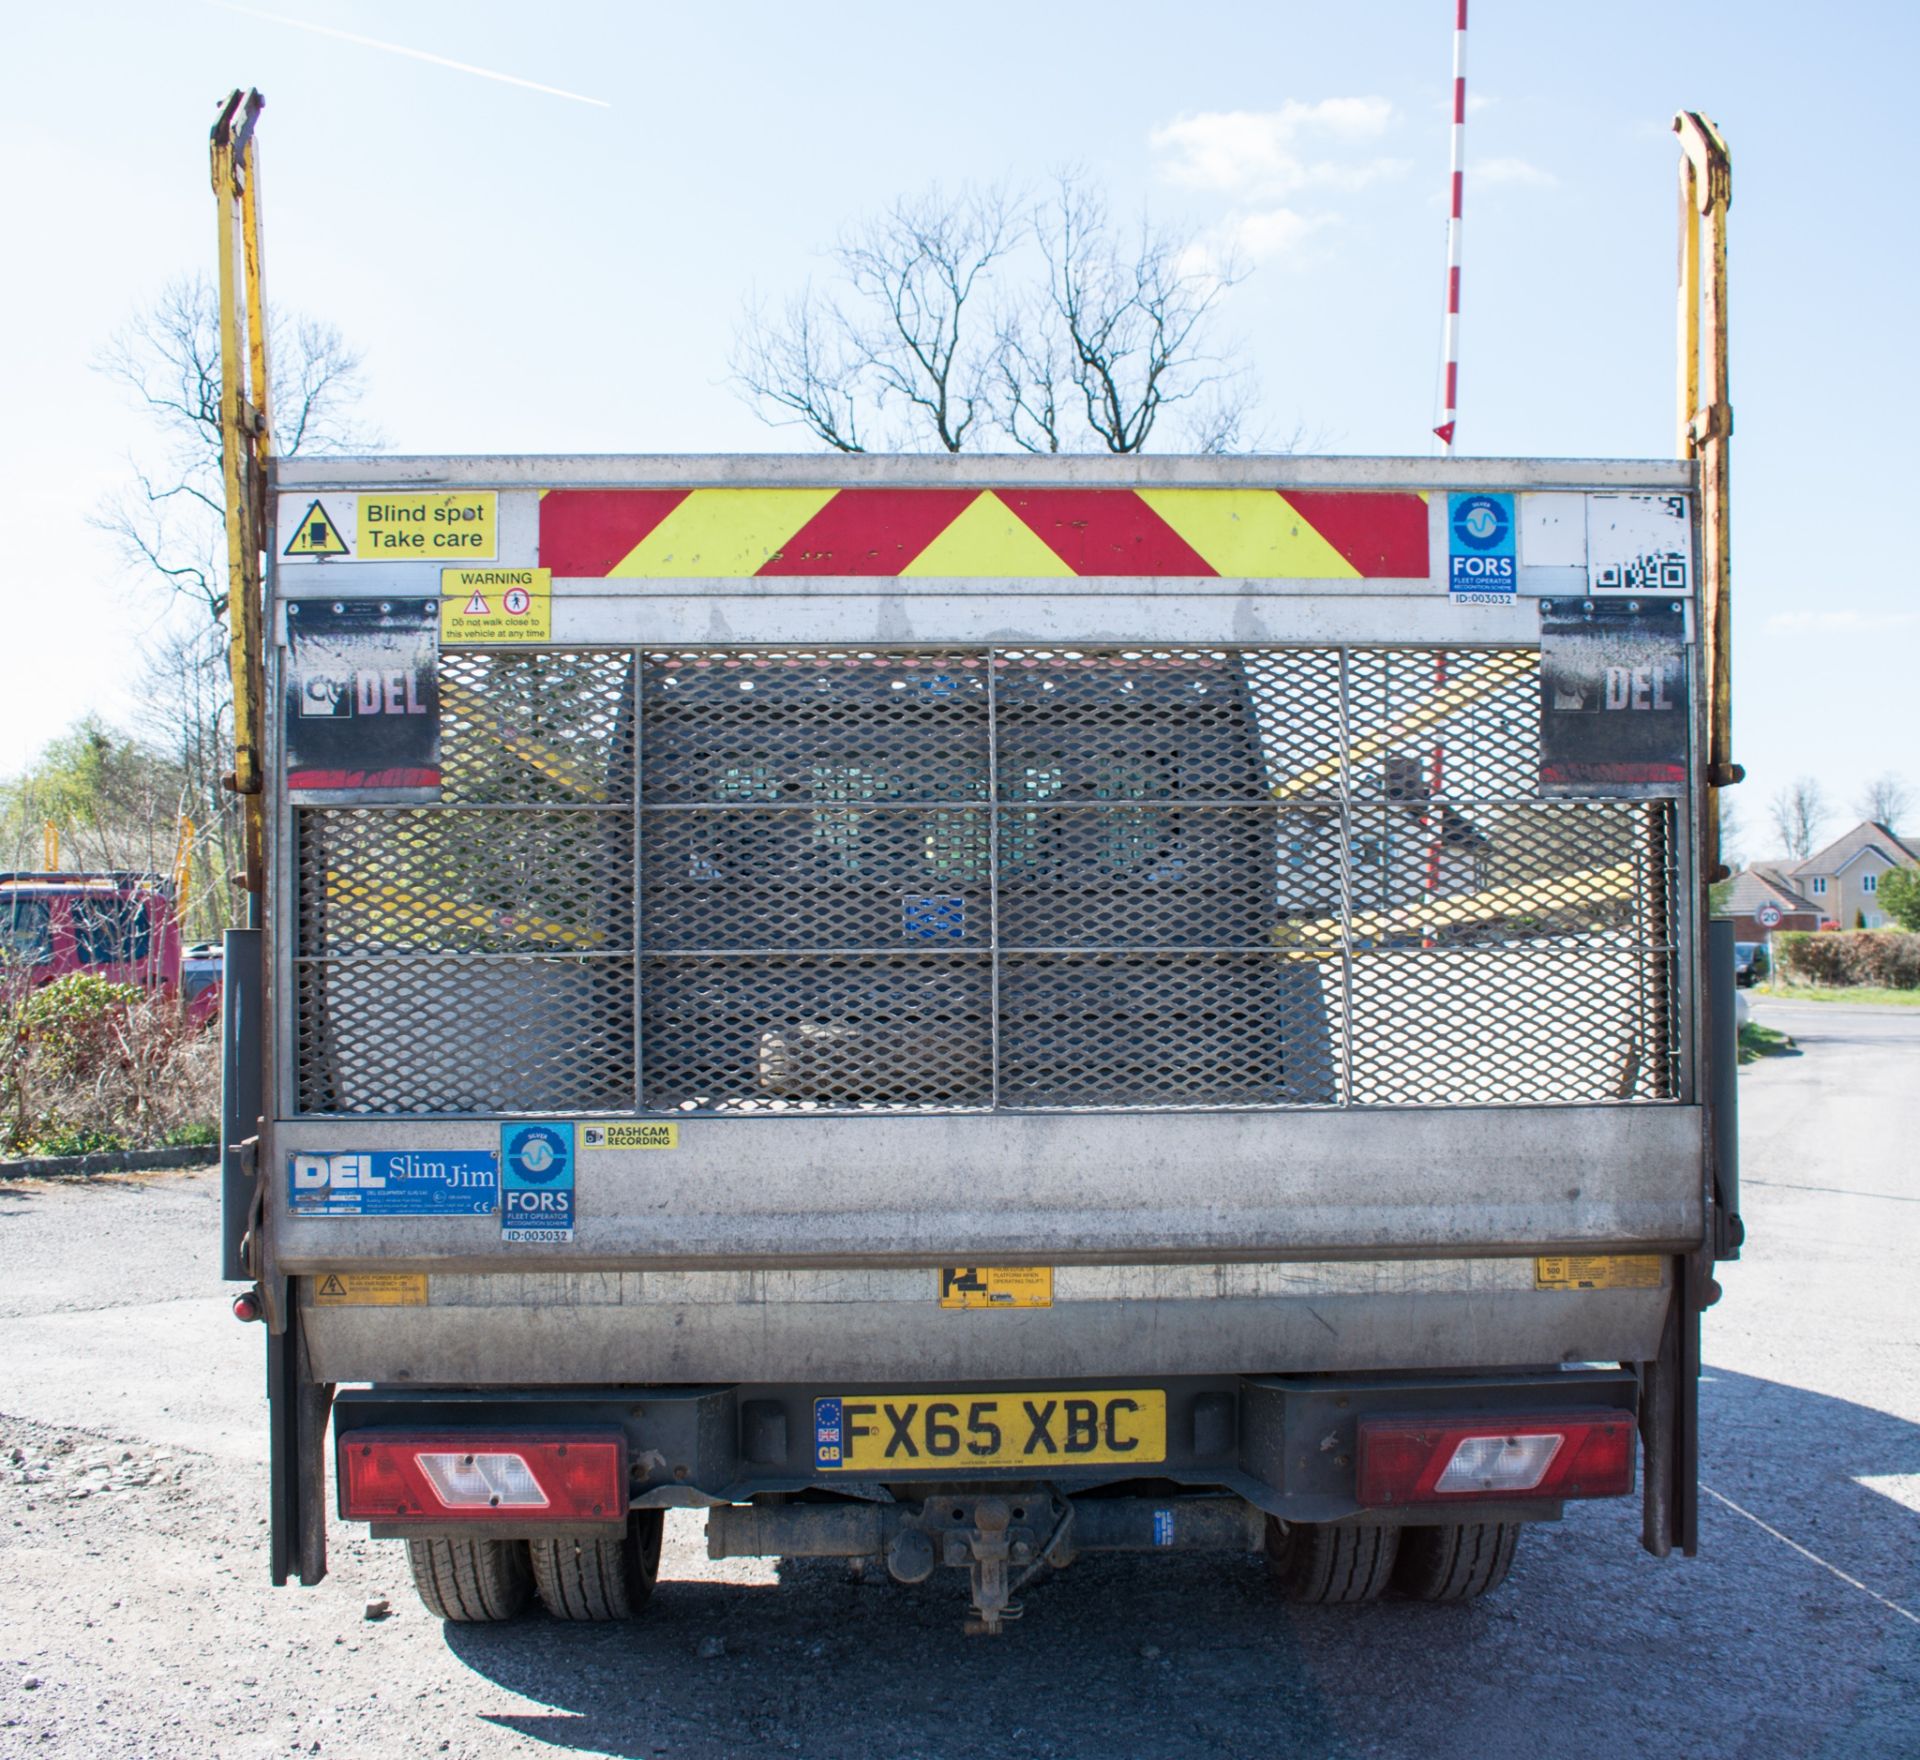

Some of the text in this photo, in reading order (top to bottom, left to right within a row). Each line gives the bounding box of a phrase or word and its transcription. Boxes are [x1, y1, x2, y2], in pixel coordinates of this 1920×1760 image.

[367, 504, 484, 526] Blind spot
[368, 530, 483, 547] Take care
[1453, 557, 1512, 576] FORS
[461, 572, 533, 585] WARNING
[1475, 577, 1512, 585] OPERATOR
[1455, 594, 1512, 604] ID:003032
[451, 618, 540, 628] Do not walk close to
[446, 630, 462, 639] this
[464, 630, 496, 639] vehicle
[507, 631, 524, 640] any
[525, 629, 545, 638] time
[357, 670, 427, 715] DEL
[1605, 666, 1673, 711] DEL
[1763, 912, 1778, 923] 20
[607, 1126, 670, 1137] DASHCAM
[607, 1135, 671, 1146] RECORDING
[295, 1155, 386, 1189] DEL
[389, 1155, 495, 1188] Slim Jim
[473, 1201, 489, 1213] CE
[507, 1192, 568, 1211] FORS
[529, 1212, 568, 1220] OPERATOR
[507, 1230, 567, 1241] ID:003032
[1546, 1266, 1561, 1275] 500
[841, 1398, 1140, 1459] FX65 XBC
[818, 1445, 840, 1461] GB
